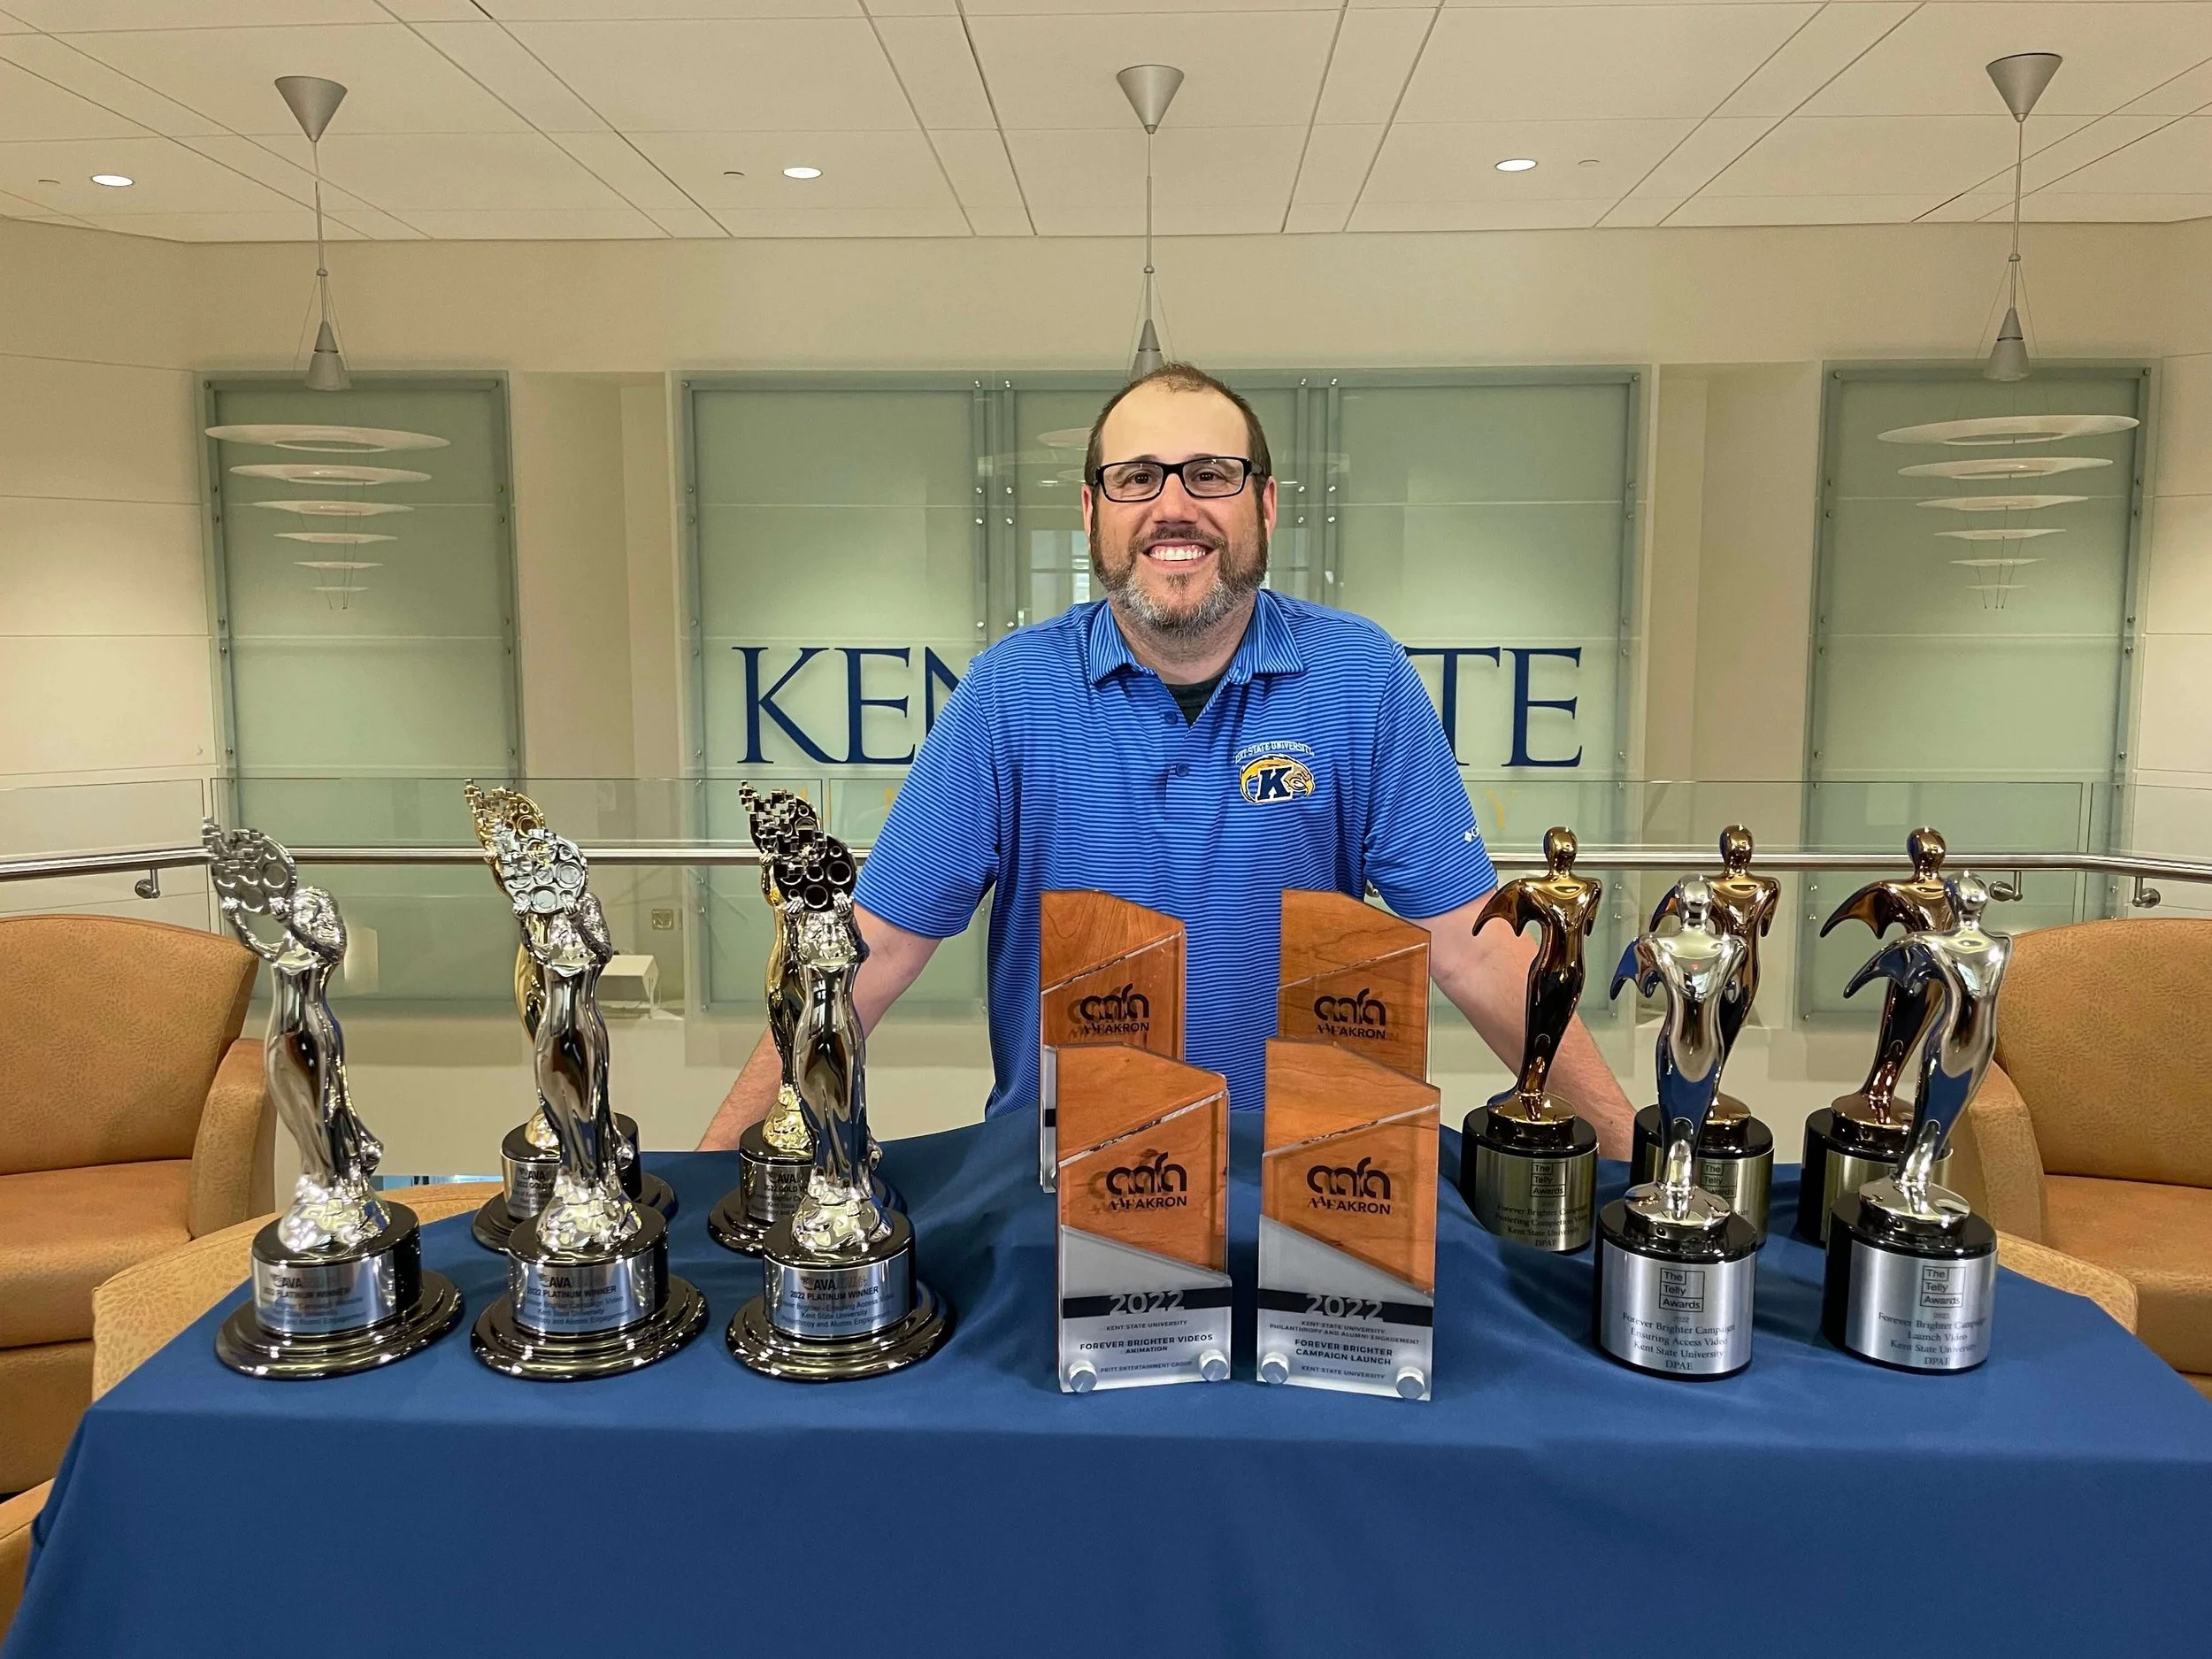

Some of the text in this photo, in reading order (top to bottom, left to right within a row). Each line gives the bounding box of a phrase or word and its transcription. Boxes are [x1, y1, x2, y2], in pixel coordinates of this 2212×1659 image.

[732, 647, 960, 764] KEN
[1248, 742, 1270, 756] STATE
[529, 1170, 546, 1180] AVA
[777, 1173, 796, 1184] AVA
[1663, 1271, 1683, 1281] The
[1926, 1269, 1946, 1279] The
[281, 1278, 302, 1288] AVA
[549, 1277, 572, 1288] AVA
[814, 1279, 836, 1291] AVA
[1924, 1282, 1948, 1293] Telly
[542, 1289, 582, 1298] PLATINUM
[584, 1285, 617, 1297] WINNER
[790, 1290, 805, 1299] 2022
[807, 1292, 847, 1301] PLATINUM
[849, 1286, 879, 1298] WINNER
[1663, 1285, 1686, 1296] Telly
[1109, 1289, 1184, 1317] 2022
[1663, 1298, 1701, 1309] Awards
[1924, 1295, 1960, 1304] Awards
[1306, 1294, 1383, 1322] 2022
[1623, 1312, 1654, 1328] Forever
[1656, 1323, 1693, 1335] Brighter
[1878, 1312, 1912, 1326] Forever
[1916, 1320, 1952, 1331] Brighter
[1270, 1323, 1322, 1334] PHILANTHROPY
[1370, 1334, 1419, 1344] ENGAGEMENT
[1344, 1325, 1386, 1334] UNIVERSITY
[1080, 1334, 1213, 1350] FOREVER BRIGHTER VIDEOS
[1631, 1326, 1728, 1346] Ensuring Access Video
[1908, 1331, 1941, 1341] Launch
[1294, 1339, 1393, 1356] FOREVER BRIGHTER
[1634, 1341, 1724, 1360] Kent State University
[1890, 1340, 1912, 1350] Kent
[1915, 1344, 1937, 1353] State
[1295, 1348, 1391, 1365] CAMPAIGN LAUNCH
[1119, 1363, 1170, 1371] ENTERTAINMENT
[1665, 1361, 1693, 1371] DPAE
[1344, 1370, 1386, 1379] UNIVERSITY
